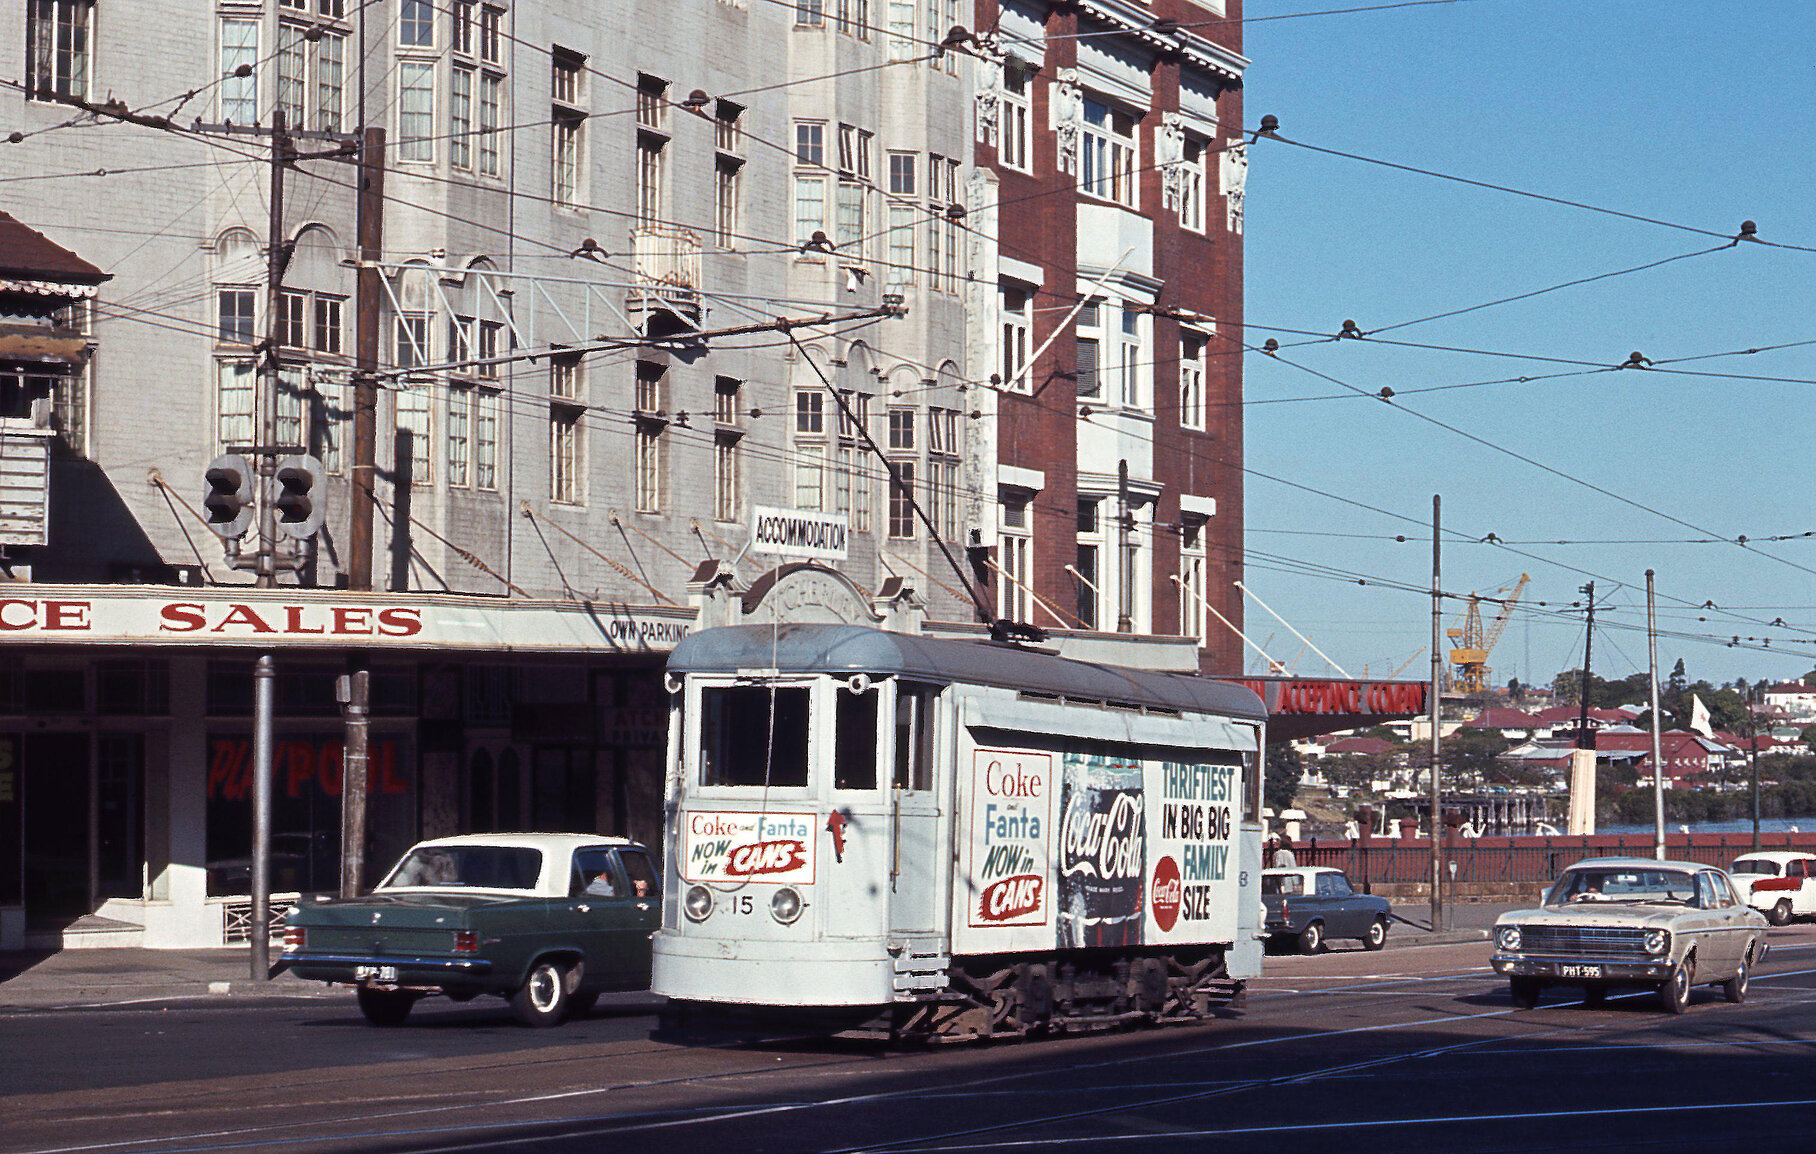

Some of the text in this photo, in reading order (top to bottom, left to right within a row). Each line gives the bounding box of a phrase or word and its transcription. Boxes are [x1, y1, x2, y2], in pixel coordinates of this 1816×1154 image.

[756, 514, 846, 551] ACCOMMODATION
[159, 603, 423, 636] SALES
[610, 620, 690, 642] OWN PARKING
[986, 760, 1042, 798] Coke
[1162, 762, 1235, 802] THRIFTIEST
[692, 815, 738, 836] Coke
[758, 817, 808, 841] Fanta
[985, 803, 1041, 845] Fanta
[1060, 792, 1143, 880] Coca-Cola
[1162, 803, 1178, 839] IN
[1208, 806, 1231, 841] BIG
[691, 840, 732, 863] NOW
[700, 860, 718, 875] in
[733, 842, 797, 872] CANS
[981, 844, 1034, 879] NOW in
[1183, 844, 1229, 880] FAMILY
[732, 895, 754, 915] 15
[989, 878, 1040, 916] CANS
[1182, 885, 1211, 921] SIZE
